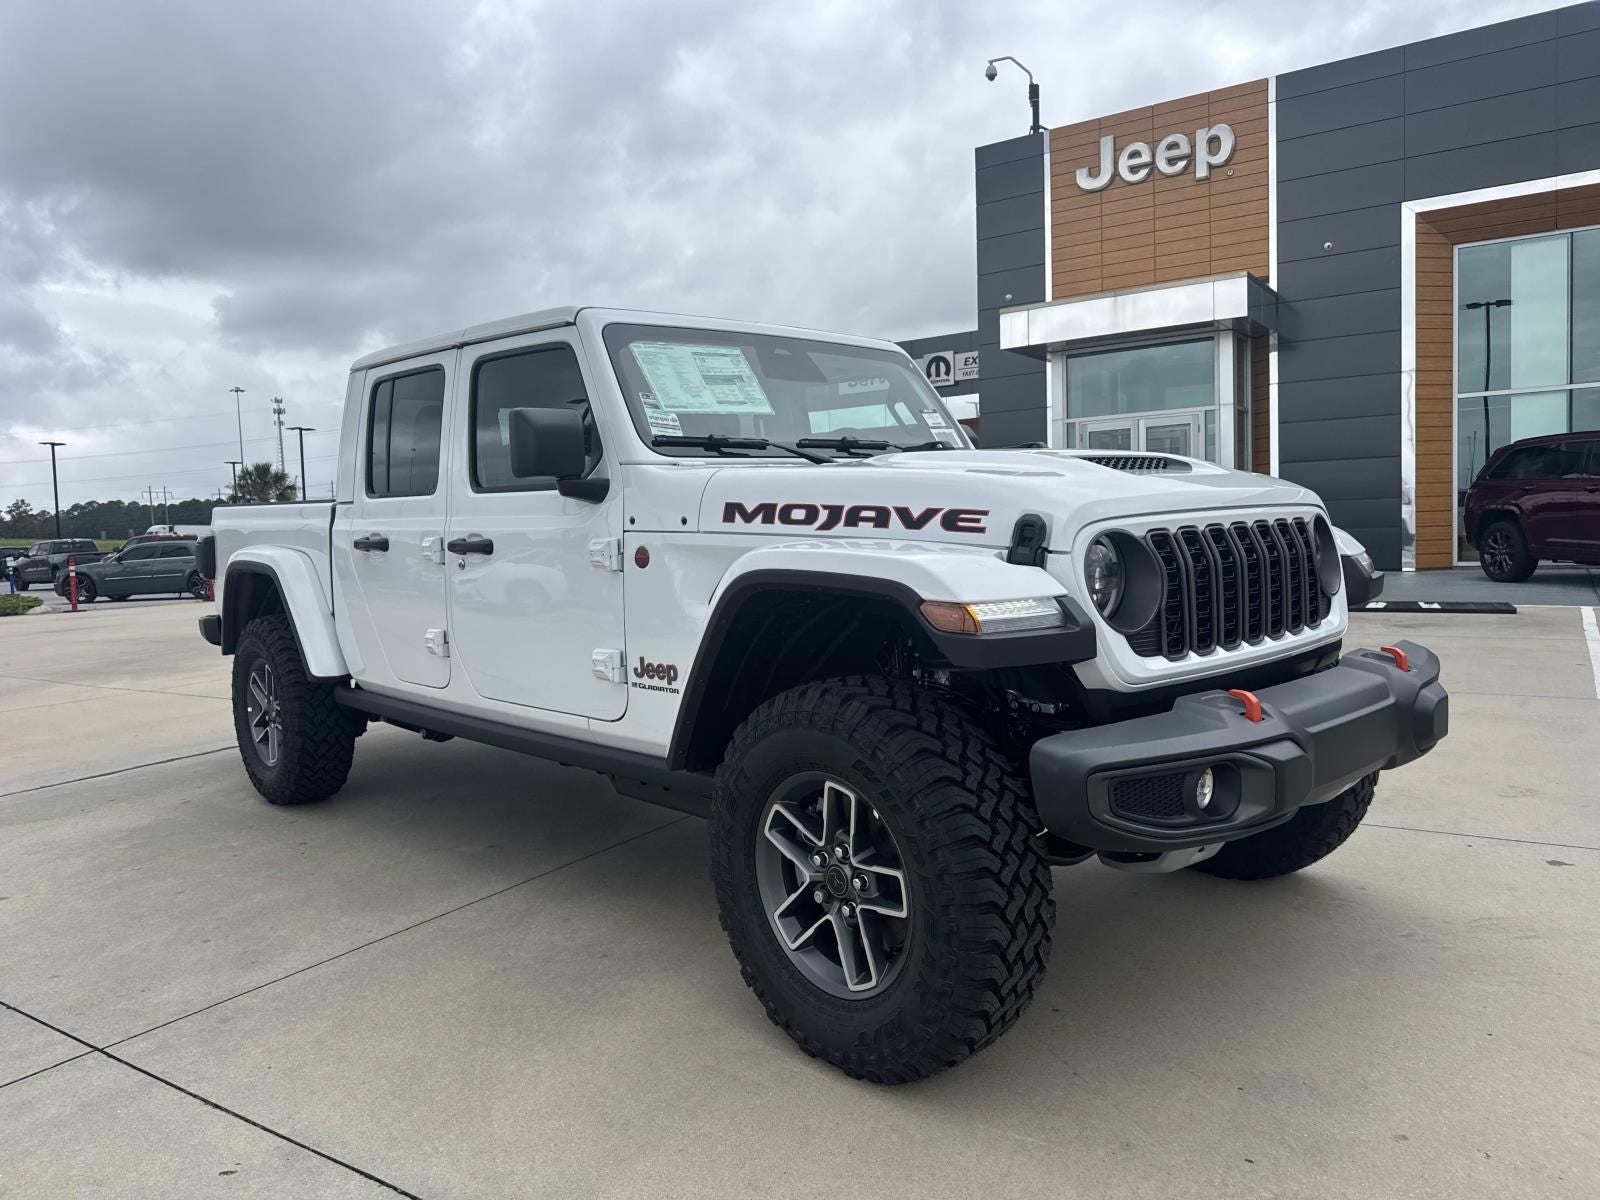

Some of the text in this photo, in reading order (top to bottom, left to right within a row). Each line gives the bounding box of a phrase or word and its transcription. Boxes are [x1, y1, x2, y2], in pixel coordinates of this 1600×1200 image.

[1076, 123, 1236, 192] Jeep
[722, 501, 990, 534] MOJAVE
[633, 656, 679, 686] Jeep
[638, 682, 680, 695] GLADIATOR
